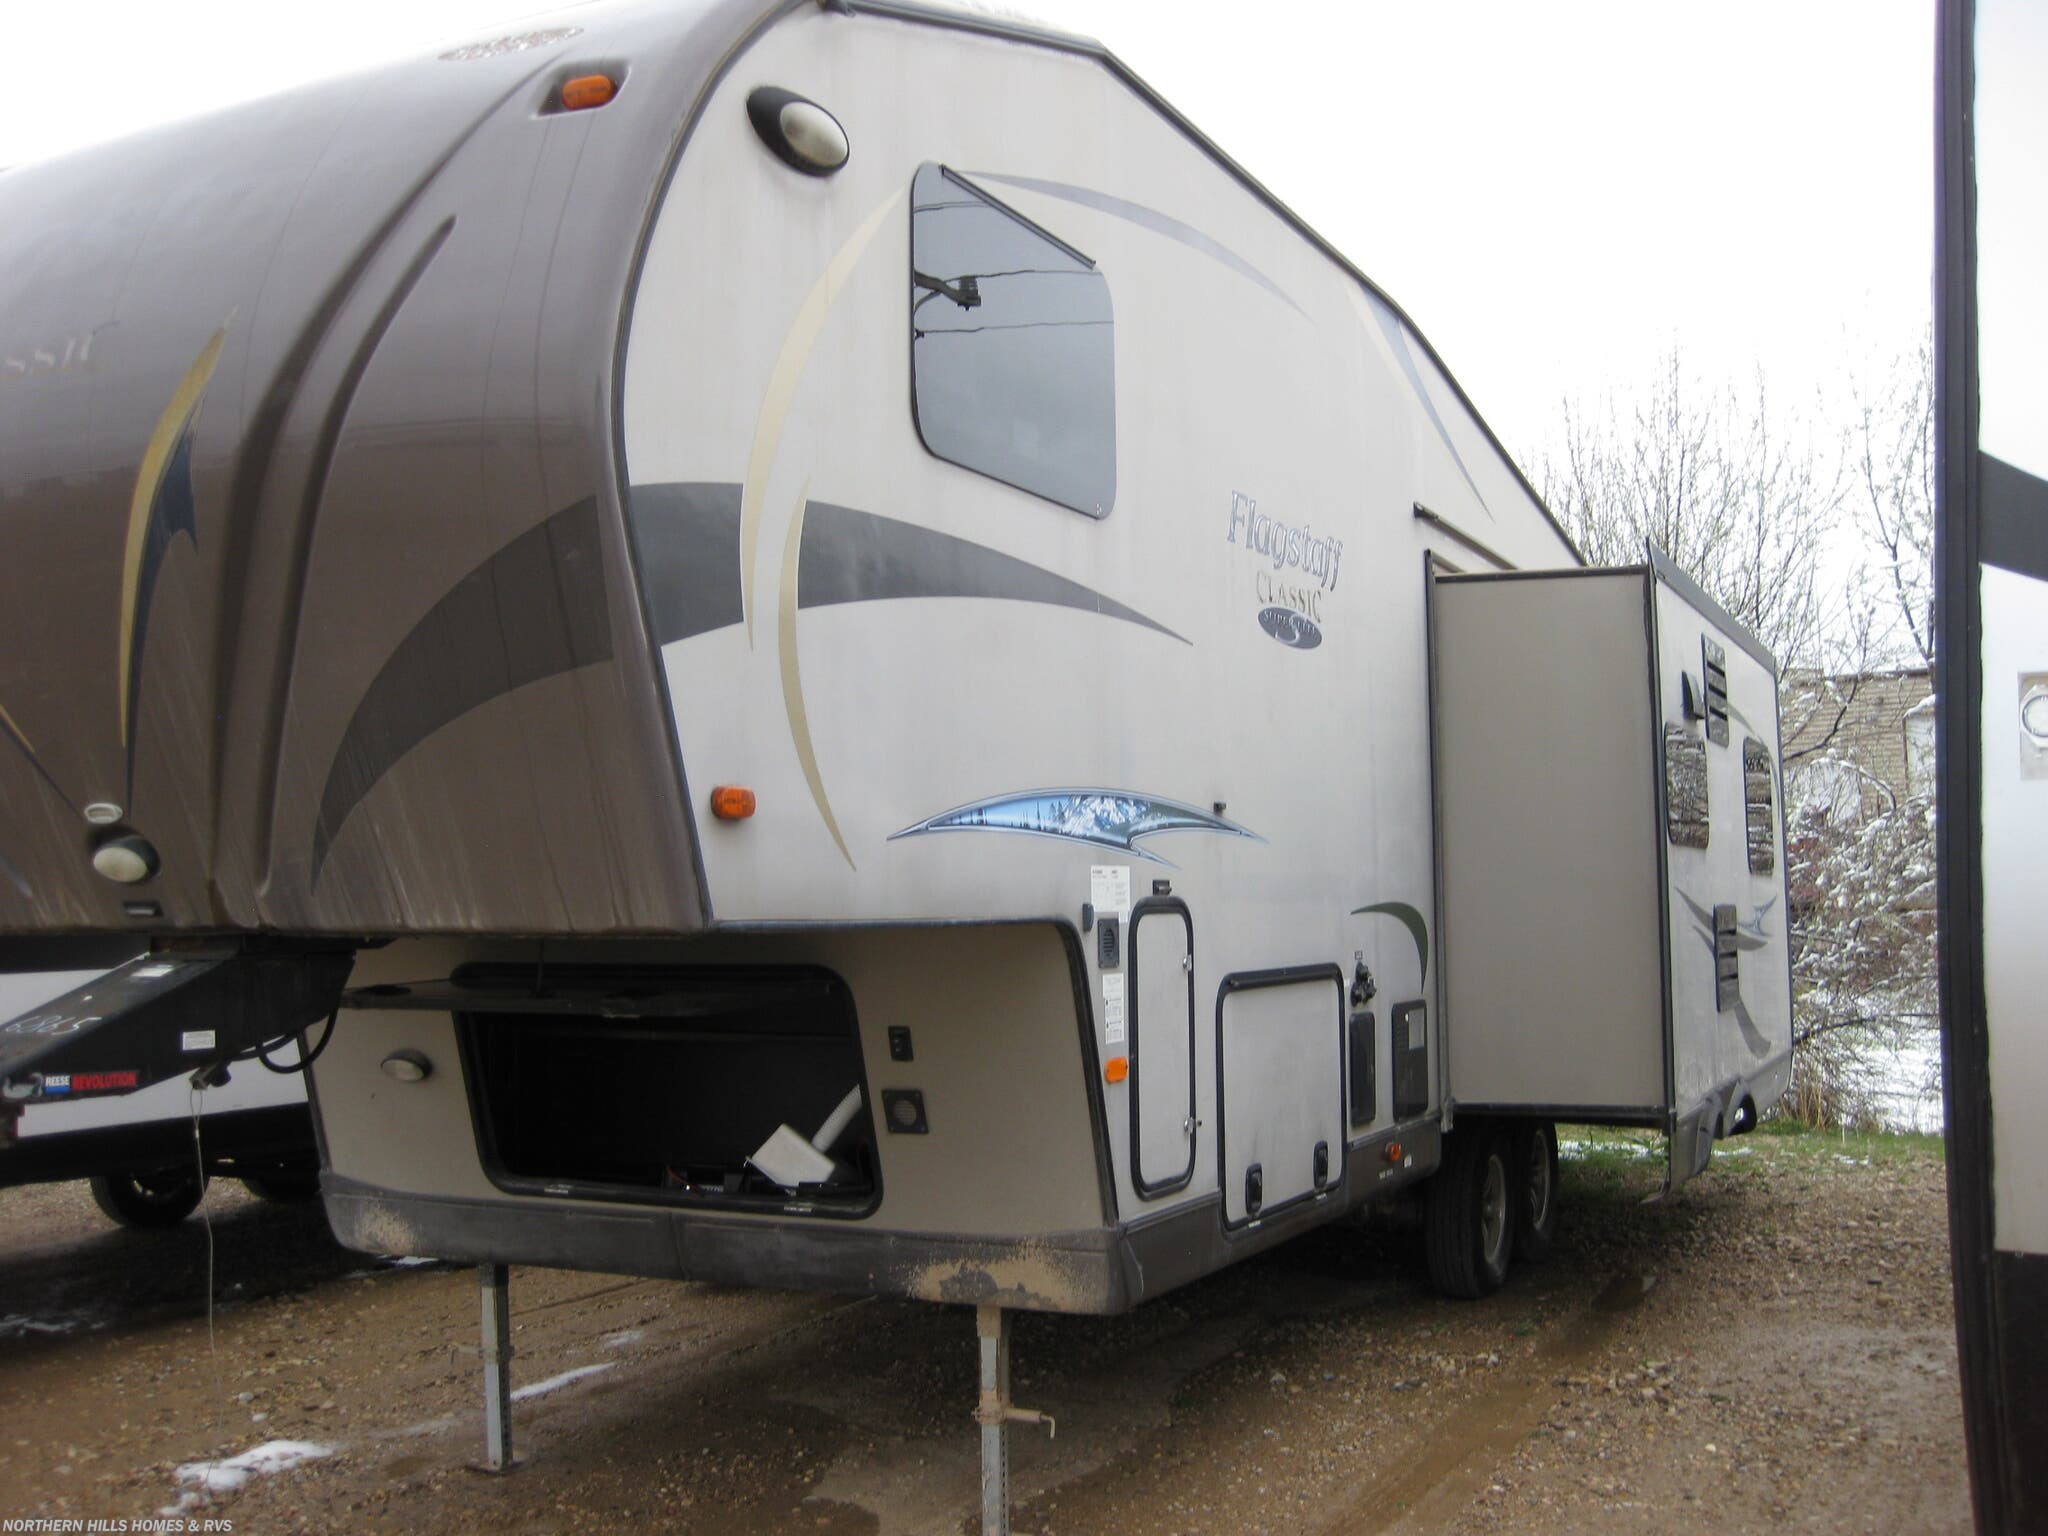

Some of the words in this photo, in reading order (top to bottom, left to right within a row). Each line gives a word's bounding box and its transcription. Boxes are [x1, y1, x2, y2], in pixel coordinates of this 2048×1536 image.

[1227, 490, 1343, 592] Flagstaff
[1256, 570, 1321, 623] CLASSIC
[46, 1075, 71, 1088] REESE
[72, 1071, 137, 1091] REVOLUTION
